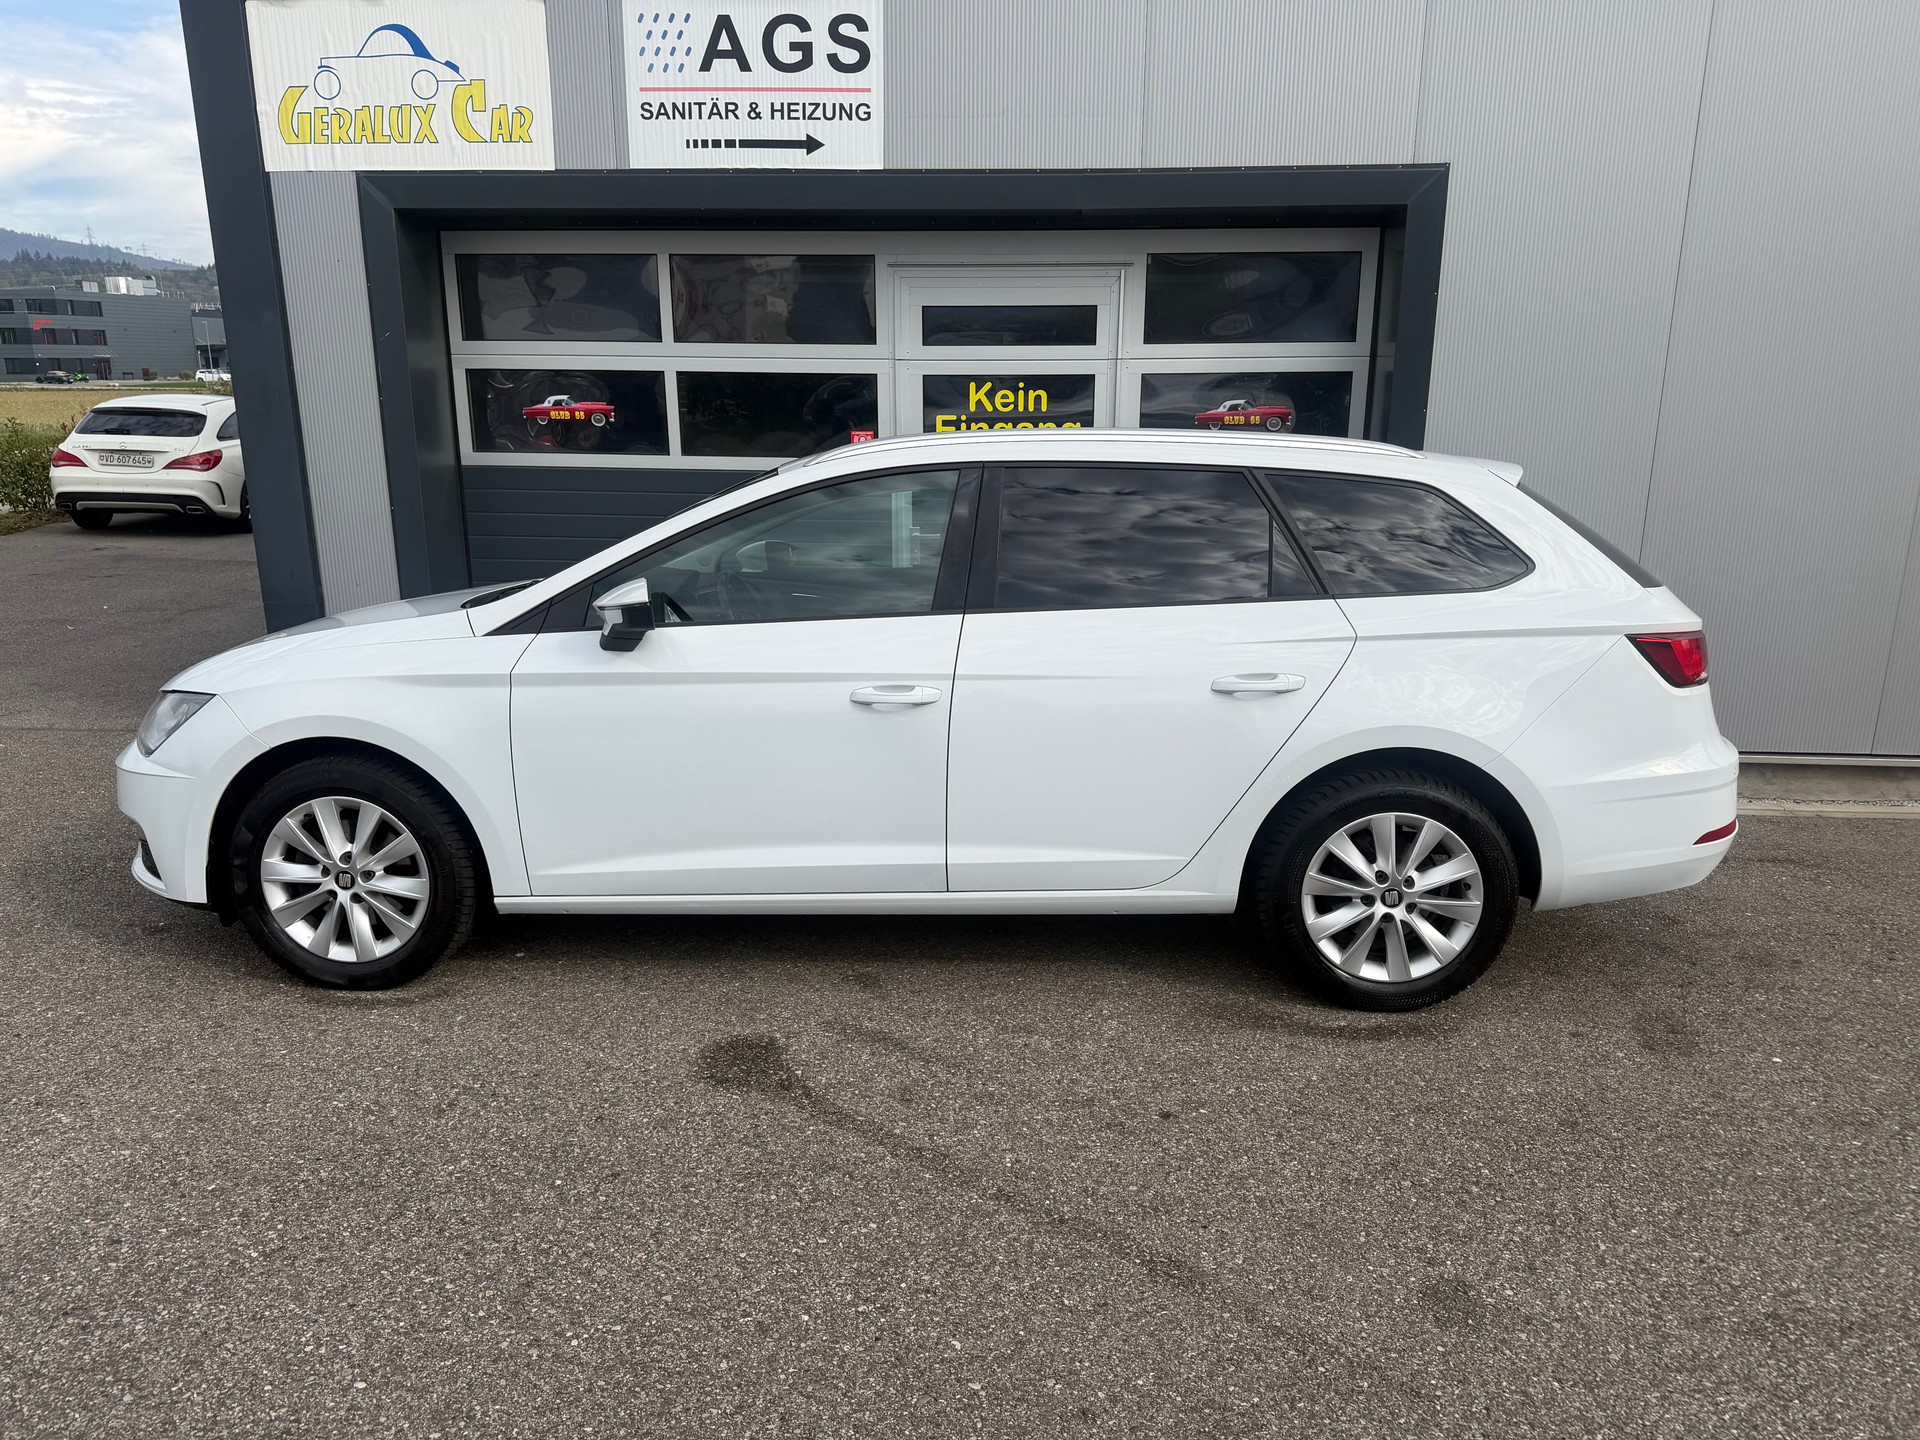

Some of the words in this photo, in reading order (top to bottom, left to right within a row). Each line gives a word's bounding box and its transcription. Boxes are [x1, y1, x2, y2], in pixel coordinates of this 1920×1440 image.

[699, 13, 871, 74] AGS
[640, 97, 740, 121] SANITÄR
[747, 102, 763, 121] &
[770, 102, 872, 121] HEIZUNG
[969, 381, 1048, 412] Kein
